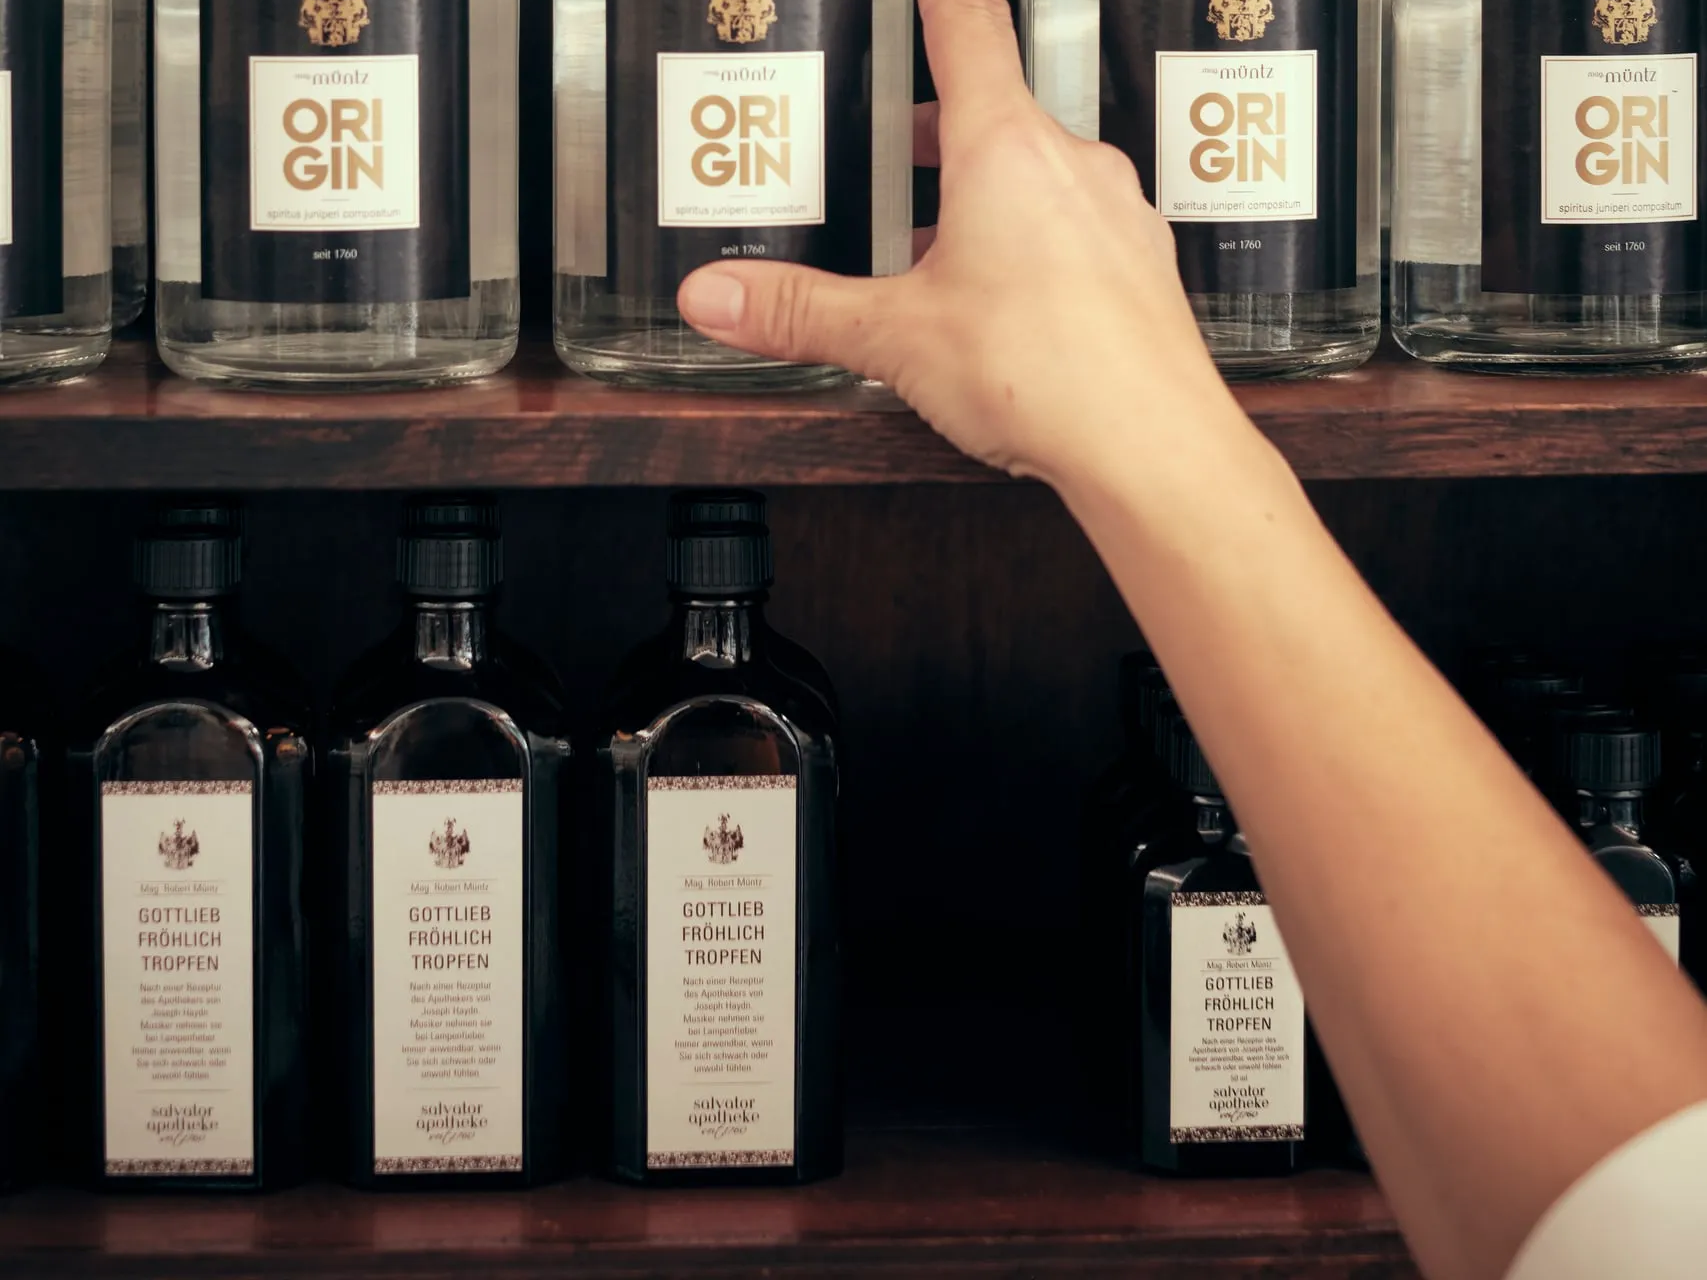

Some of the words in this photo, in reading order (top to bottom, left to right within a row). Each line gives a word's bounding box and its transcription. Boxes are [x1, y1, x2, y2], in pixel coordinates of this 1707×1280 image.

[1219, 64, 1274, 80] müntz
[1605, 67, 1657, 83] müntz
[282, 98, 383, 143] ORI
[690, 94, 791, 140] ORI
[1189, 92, 1286, 137] ORI
[1575, 94, 1669, 140] ORI
[283, 145, 384, 191] GIN
[691, 142, 791, 187] GIN
[1189, 138, 1287, 183] GIN
[1575, 141, 1669, 186] GIN
[675, 205, 709, 216] spiritus
[711, 205, 748, 217] juniperi
[1173, 200, 1208, 211] spiritus
[1210, 200, 1245, 212] juniperi
[1247, 200, 1301, 211] compositum
[1559, 203, 1593, 214] spiritus
[1595, 202, 1630, 214] juniperi
[1632, 201, 1682, 213] compositum
[266, 209, 301, 220] spiritus
[303, 209, 339, 221] juniperi
[721, 244, 739, 256] seit
[742, 244, 765, 255] 1760
[1218, 240, 1236, 250] seit
[1239, 239, 1261, 250] 1760
[1604, 242, 1621, 252] seit
[1625, 241, 1645, 251] 1760
[312, 249, 331, 260] seit
[334, 248, 358, 259] 1760
[139, 907, 221, 924] GOTTLIEB
[409, 906, 491, 922] GOTTLIEB
[683, 901, 764, 918] GOTTLIEB
[138, 928, 221, 948] FRÖHLICH
[409, 926, 492, 946] FRÖHLICH
[682, 922, 765, 942] FRÖHLICH
[142, 956, 219, 971] TROPFEN
[411, 954, 489, 970] TROPFEN
[685, 949, 762, 965] TROPFEN
[1205, 976, 1274, 991] GOTTLIEB
[701, 989, 746, 999] Apothekers
[694, 1002, 723, 1012] Joseph
[1205, 994, 1274, 1012] FRÖHLICH
[1207, 1017, 1272, 1032] TROPFEN
[1213, 1085, 1265, 1098] salvator
[151, 1103, 214, 1118] salvator
[421, 1101, 484, 1116] salvator
[693, 1096, 756, 1110] salvator
[1209, 1097, 1269, 1112] apotheke
[146, 1117, 219, 1134] apotheke
[416, 1115, 488, 1132] apotheke
[688, 1110, 760, 1127] apotheke
